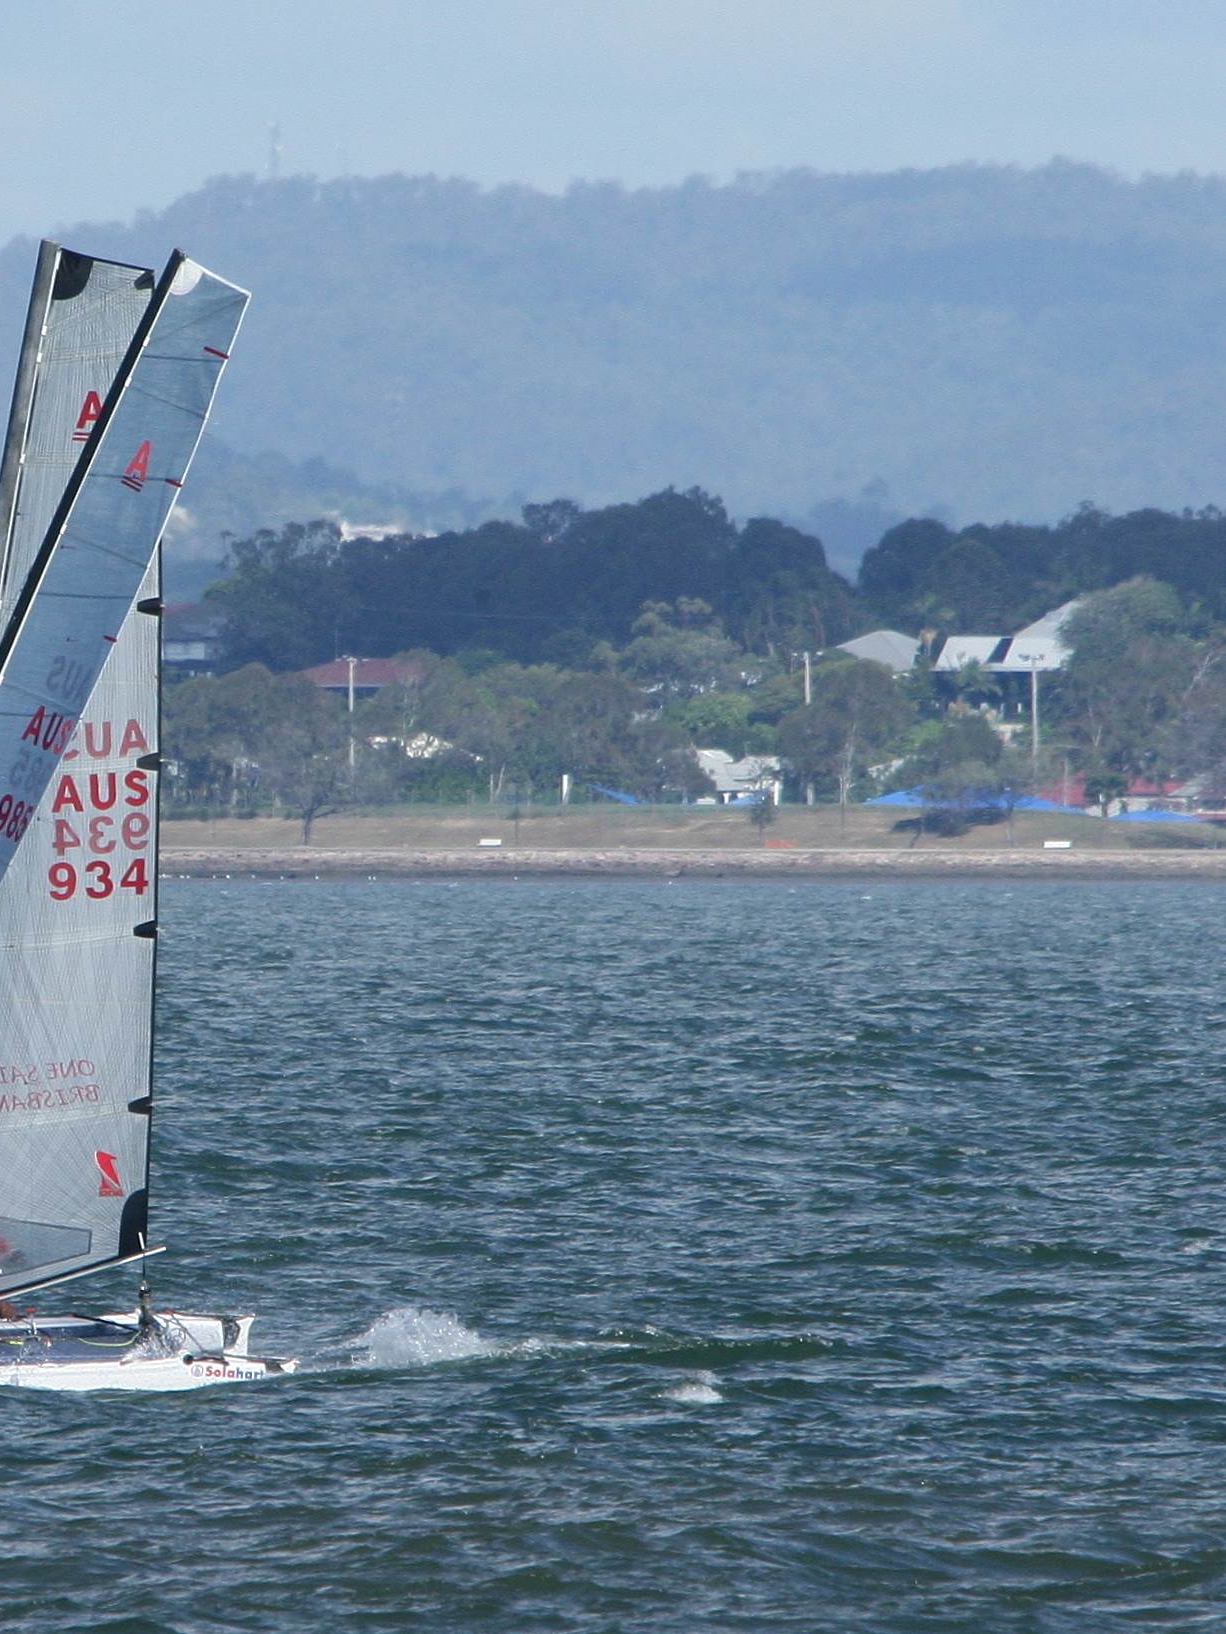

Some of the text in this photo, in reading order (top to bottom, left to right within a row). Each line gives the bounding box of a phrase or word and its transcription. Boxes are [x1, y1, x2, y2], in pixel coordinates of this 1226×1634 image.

[124, 439, 153, 481] A
[52, 770, 149, 813] AUS
[48, 858, 149, 901] 934
[205, 1365, 264, 1379] Solahart
